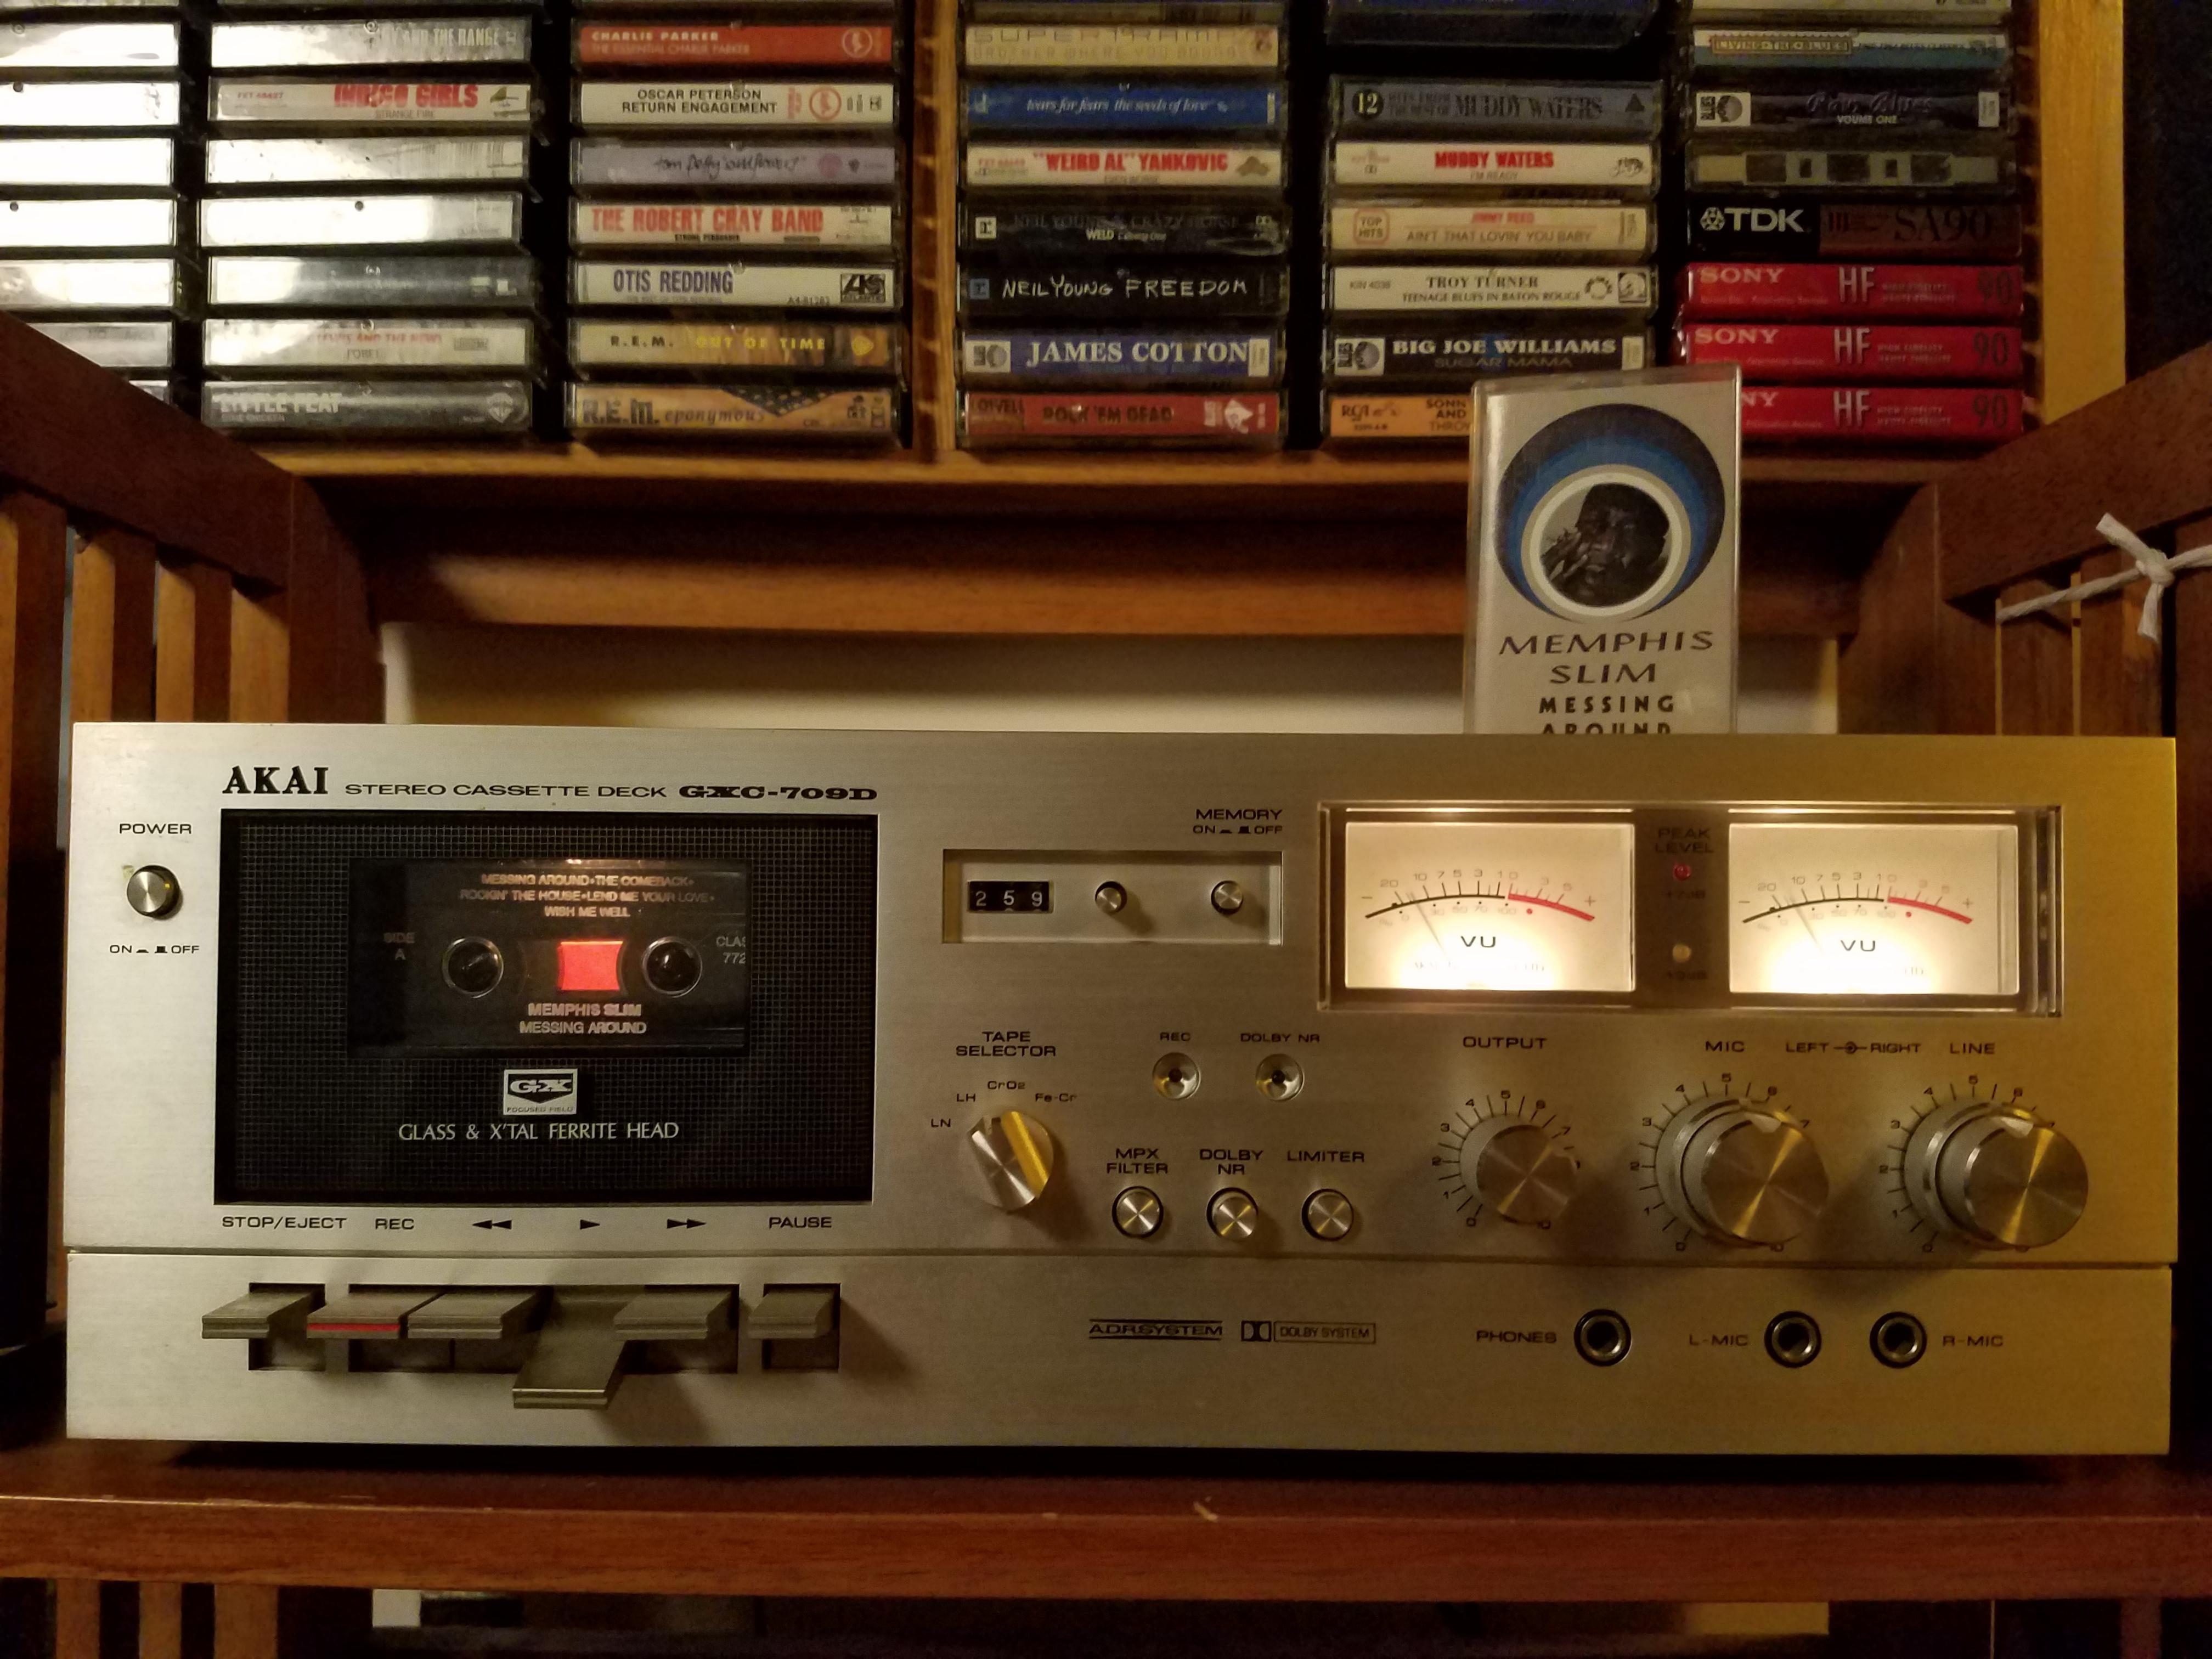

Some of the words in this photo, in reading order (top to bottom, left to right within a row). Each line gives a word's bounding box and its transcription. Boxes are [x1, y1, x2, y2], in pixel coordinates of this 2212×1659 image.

[458, 28, 500, 46] RANGE
[591, 31, 654, 42] CHARLIE
[661, 31, 719, 42] PARKER
[415, 83, 479, 108] GIRLS
[637, 90, 685, 100] OSCAR
[689, 89, 762, 100] PETERSON
[621, 102, 676, 114] RETURN
[681, 102, 777, 114] ENGAGEMENT
[1356, 92, 1378, 114] 12
[1528, 95, 1602, 119] WATERS
[1034, 151, 1100, 172] "WEIRD
[1104, 151, 1136, 172] AL"
[1138, 152, 1229, 172] YANKOVIC
[1434, 150, 1490, 168] MUDDY
[1495, 151, 1554, 168] WATERS
[592, 208, 624, 233] THE
[633, 208, 704, 233] ROBERT
[713, 208, 765, 233] CRAY
[771, 208, 823, 233] BAND
[1361, 216, 1383, 226] TOP
[1724, 207, 1804, 233] TDK
[1894, 206, 1993, 242] SA90
[1358, 227, 1384, 239] HITS
[1406, 230, 1438, 242] AIN'T
[1444, 230, 1476, 242] THAT
[1480, 230, 1521, 243] LOVIN'
[1526, 231, 1554, 243] YOU
[1556, 231, 1593, 243] BABY
[613, 269, 651, 293] OTIS
[659, 270, 734, 294] REDDING
[1002, 278, 1049, 298] NEIL
[1049, 274, 1114, 297] YOUNG
[1125, 277, 1248, 298] FREEDOM
[1426, 276, 1467, 289] TROY
[1474, 275, 1539, 289] TURNER
[1699, 267, 1786, 285] SONY
[1838, 266, 1875, 303] HF
[1977, 269, 2015, 306] 90
[1402, 292, 1451, 302] TEENAGE
[1451, 292, 1486, 302] BLUES
[1487, 292, 1498, 302] IN
[1502, 291, 1539, 302] BATON
[1542, 291, 1581, 302] ROUGE
[611, 336, 674, 347] R.E.M.
[695, 337, 732, 349] OUT
[744, 337, 768, 349] OF
[780, 337, 826, 350] TIME
[1393, 338, 1436, 354] BIG
[1442, 339, 1487, 355] JOE
[1495, 338, 1617, 355] WILLIAMS
[1694, 328, 1780, 345] SONY
[1833, 327, 1871, 365] HF
[1974, 332, 2009, 368] 90
[1026, 341, 1123, 368] JAMES
[1131, 341, 1249, 363] COTTON
[1435, 357, 1503, 369] SUGAR
[1506, 357, 1573, 369] MAMA
[219, 393, 289, 413] LITTLE
[291, 392, 344, 411] FEAT
[582, 398, 661, 426] R.E.M.
[664, 405, 766, 425] eponymous
[1126, 407, 1175, 422] DEAD
[1436, 409, 1466, 420] AND
[1833, 390, 1871, 427] HF
[1974, 392, 2009, 430] 90
[1498, 630, 1714, 656] MEMPHIS
[1549, 663, 1656, 684] SLIM
[1539, 695, 1674, 714] MESSING
[1542, 723, 1671, 734] AROUND
[222, 765, 329, 794] AKAI
[345, 783, 447, 795] STEREO
[453, 784, 591, 797] CASSETTE
[597, 785, 667, 798] DECK
[679, 785, 878, 800] GXC-709D
[1195, 809, 1284, 820] MEMORY
[119, 823, 192, 834] POWER
[1192, 825, 1216, 834] ON
[1254, 825, 1283, 834] OFF
[1657, 827, 1711, 839] PEAK
[1655, 843, 1714, 854] LEVEL
[481, 874, 537, 887] MESSING
[537, 874, 589, 887] AROUND
[595, 874, 619, 887] THE
[620, 874, 687, 887] COMEBACK
[460, 889, 509, 901] ROCKIN'
[512, 889, 537, 901] THE
[538, 889, 582, 901] HOUSE
[586, 890, 618, 902] LEND
[620, 890, 639, 902] ME
[641, 890, 676, 902] YOUR
[678, 891, 709, 902] LOVE
[975, 890, 1043, 907] 259
[543, 905, 575, 918] WISH
[578, 905, 597, 918] ME
[599, 906, 631, 918] WELL
[1460, 935, 1497, 948] VU
[1840, 939, 1877, 952] VU
[109, 944, 133, 954] ON
[170, 945, 200, 954] OFF
[394, 948, 407, 960] A
[528, 1003, 601, 1016] MEMPHIS
[603, 1003, 642, 1017] SLIM
[519, 1021, 585, 1034] MESSING
[588, 1021, 647, 1034] AROUND
[982, 1031, 1031, 1042] TAPE
[1159, 1032, 1191, 1042] REC
[1240, 1032, 1291, 1043] DOLBY
[1297, 1033, 1321, 1043] NR
[1462, 1036, 1548, 1049] OUTPUT
[955, 1045, 1057, 1057] SELECTOR
[1704, 1040, 1746, 1053] MIC
[1786, 1042, 1830, 1053] LEFT
[1870, 1042, 1922, 1054] RIGHT
[1949, 1043, 1996, 1055] LINE
[509, 1077, 573, 1094] GX
[956, 1093, 977, 1103] LH
[1034, 1093, 1078, 1103] Fe-Cr
[930, 1118, 952, 1128] LN
[398, 1124, 456, 1141] GLASS
[466, 1124, 480, 1140] &
[489, 1123, 538, 1140] X'TAL
[549, 1122, 617, 1139] FERRITE
[627, 1121, 680, 1139] HEAD
[1115, 1148, 1160, 1160] MPX
[1199, 1149, 1263, 1161] DOLBY
[1286, 1150, 1365, 1163] LIMITER
[1106, 1163, 1169, 1175] FILTER
[1217, 1164, 1245, 1175] NR
[222, 1216, 347, 1229] STOP/EJECT
[375, 1218, 415, 1230] REC
[768, 1216, 833, 1229] PAUSE
[1279, 1325, 1318, 1338] DOLBY
[1321, 1327, 1370, 1339] SYSTEM
[1476, 1330, 1557, 1344] PHONES
[1689, 1334, 1749, 1347] L-MIC
[1942, 1335, 2004, 1347] R-MIC
